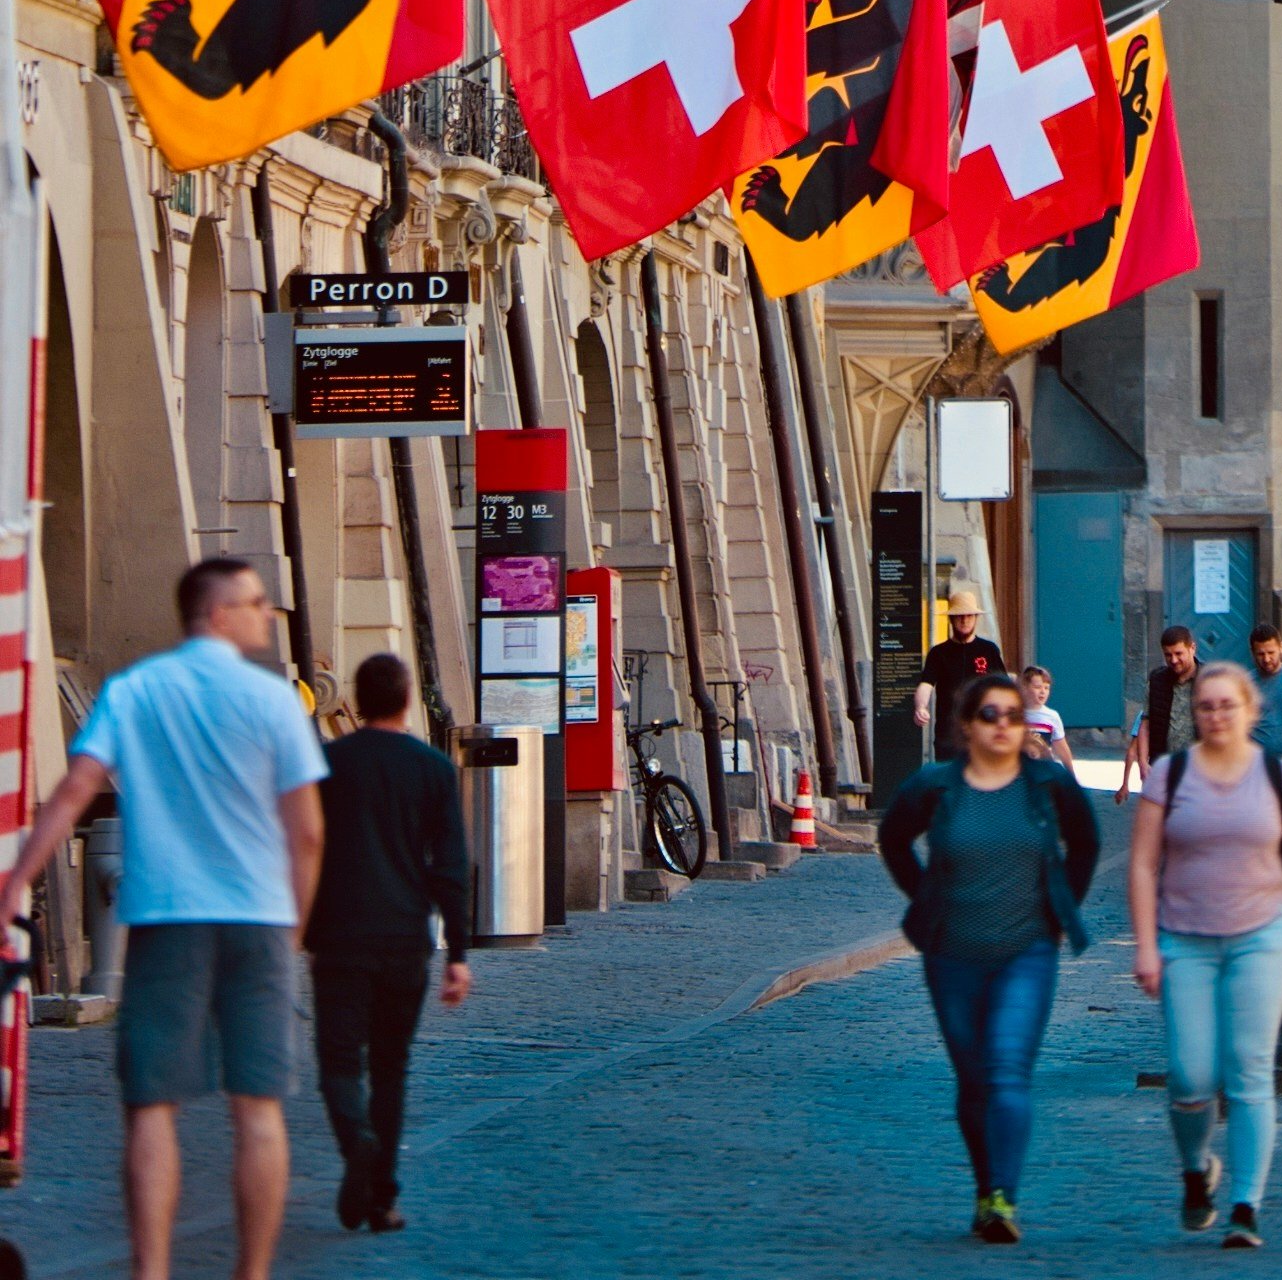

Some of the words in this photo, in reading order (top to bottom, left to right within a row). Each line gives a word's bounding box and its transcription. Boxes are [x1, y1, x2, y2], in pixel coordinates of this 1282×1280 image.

[310, 278, 414, 301] Perron
[428, 276, 449, 299] D
[303, 347, 359, 359] Zytglogge
[482, 505, 497, 520] 12
[507, 505, 525, 520] 30
[532, 504, 548, 515] M3
